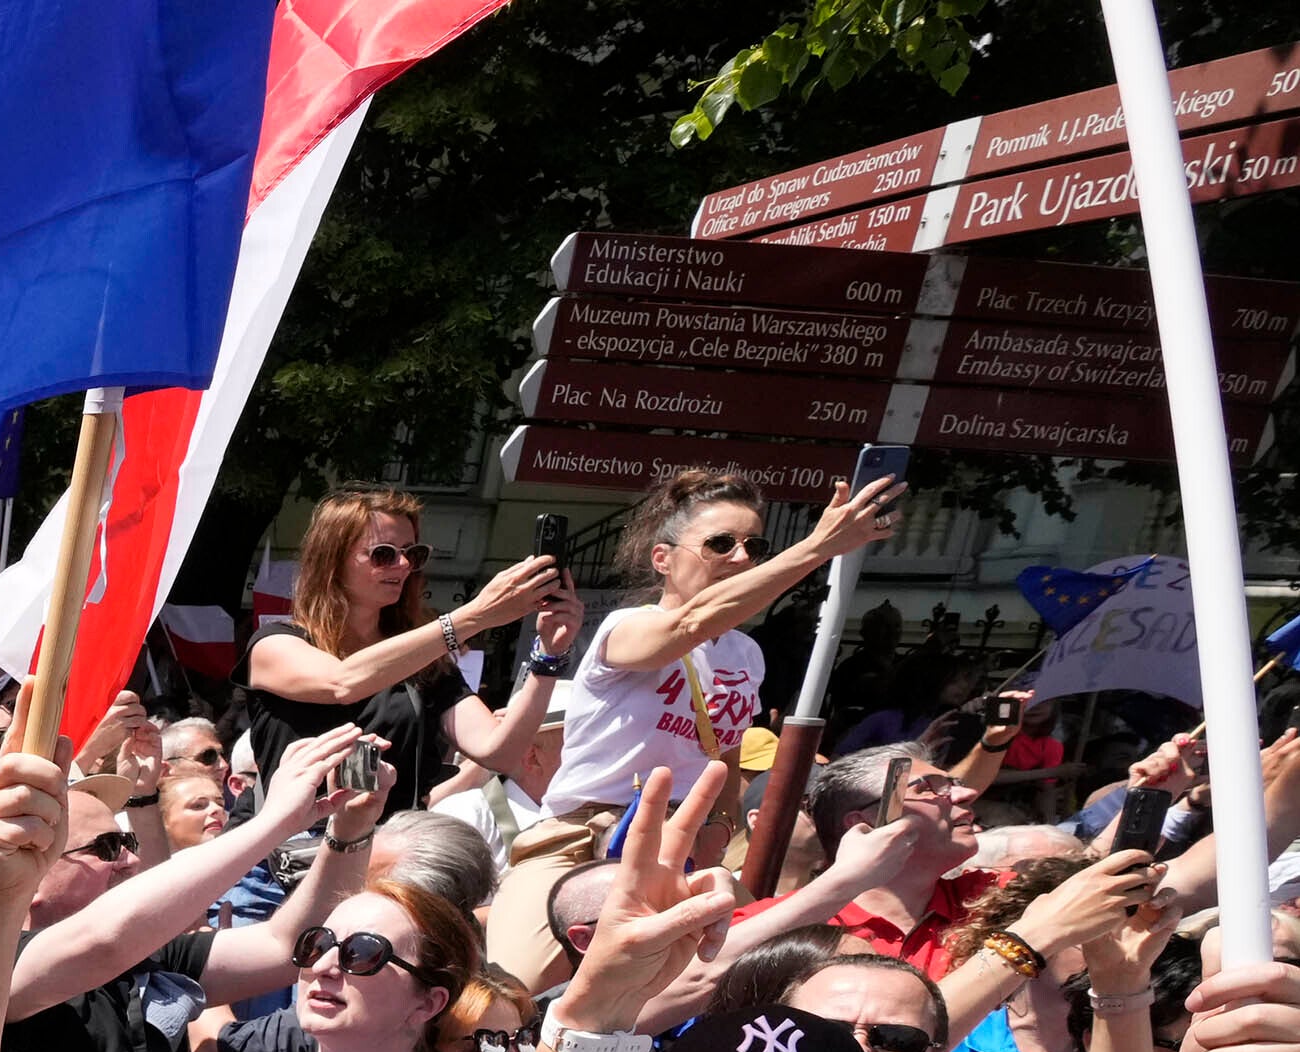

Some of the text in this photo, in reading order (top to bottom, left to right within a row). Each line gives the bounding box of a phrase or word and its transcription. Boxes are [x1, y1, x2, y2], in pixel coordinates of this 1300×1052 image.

[986, 124, 1052, 159] Pomnik
[708, 143, 922, 216] Urząd do Spraw Cudzoziemców
[964, 141, 1298, 229] Park Ujazdski 50 m
[702, 167, 921, 237] Office for Foreigners 250 m
[818, 214, 859, 243] Serbii
[867, 205, 894, 228] 150
[895, 205, 911, 222] m
[589, 239, 724, 267] Ministerstwo
[584, 263, 902, 304] Edukacji i Nauki 600 m
[569, 303, 887, 346] Muzeum Powstania Warszawskiego
[977, 287, 1017, 310] Plac
[1026, 291, 1086, 316] Trzech
[1232, 308, 1267, 330] 700
[1268, 314, 1288, 332] m
[577, 331, 674, 360] ekspozycja
[820, 344, 857, 365] 380
[864, 351, 884, 367] m
[965, 330, 1068, 356] Ambasada
[957, 354, 1045, 386] Embassy
[1048, 359, 1073, 382] of
[1247, 378, 1268, 396] m
[551, 384, 868, 424] Plac Na Rozdrożu 250 m
[939, 414, 1005, 438] Dolina
[1010, 418, 1129, 450] Szwajcarska
[533, 450, 643, 476] Ministerstwo
[791, 467, 824, 488] 100
[656, 669, 686, 705] 4
